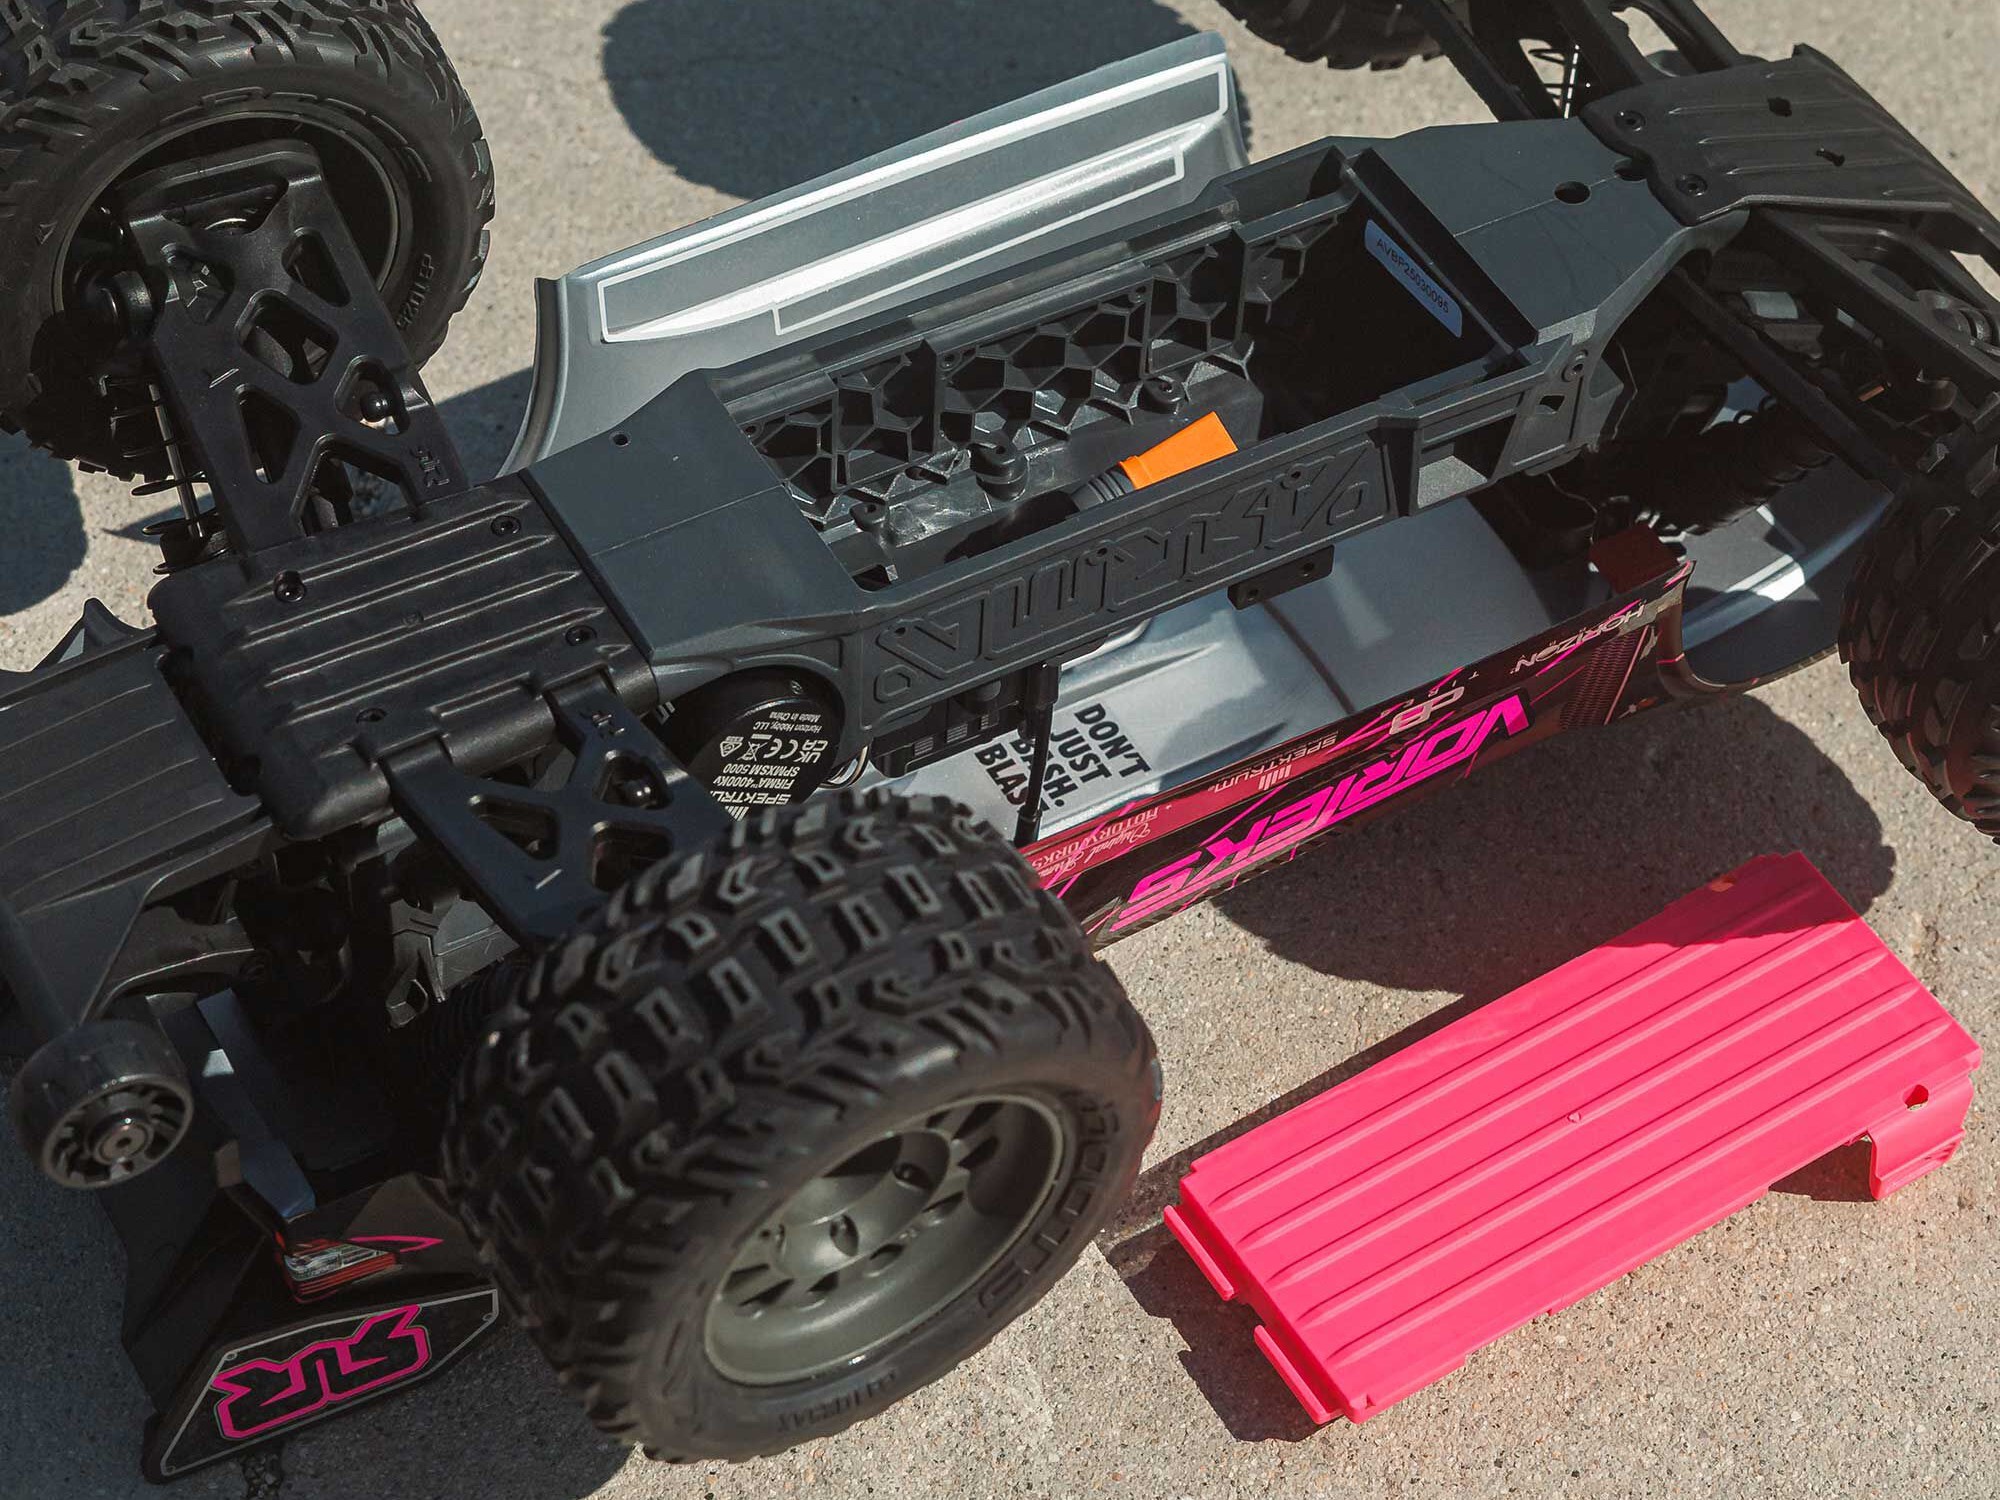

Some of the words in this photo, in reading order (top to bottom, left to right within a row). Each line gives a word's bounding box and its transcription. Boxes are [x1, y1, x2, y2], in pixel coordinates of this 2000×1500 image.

[768, 711, 791, 722] China
[789, 712, 799, 721] in
[799, 713, 821, 724] Made
[753, 721, 770, 730] LLC
[794, 722, 822, 734] Horizon
[1074, 703, 1152, 778] DON'T
[1050, 727, 1112, 784] JUST
[1208, 732, 1337, 793] SPEKTRUM
[1108, 694, 1530, 933] VORTEKS
